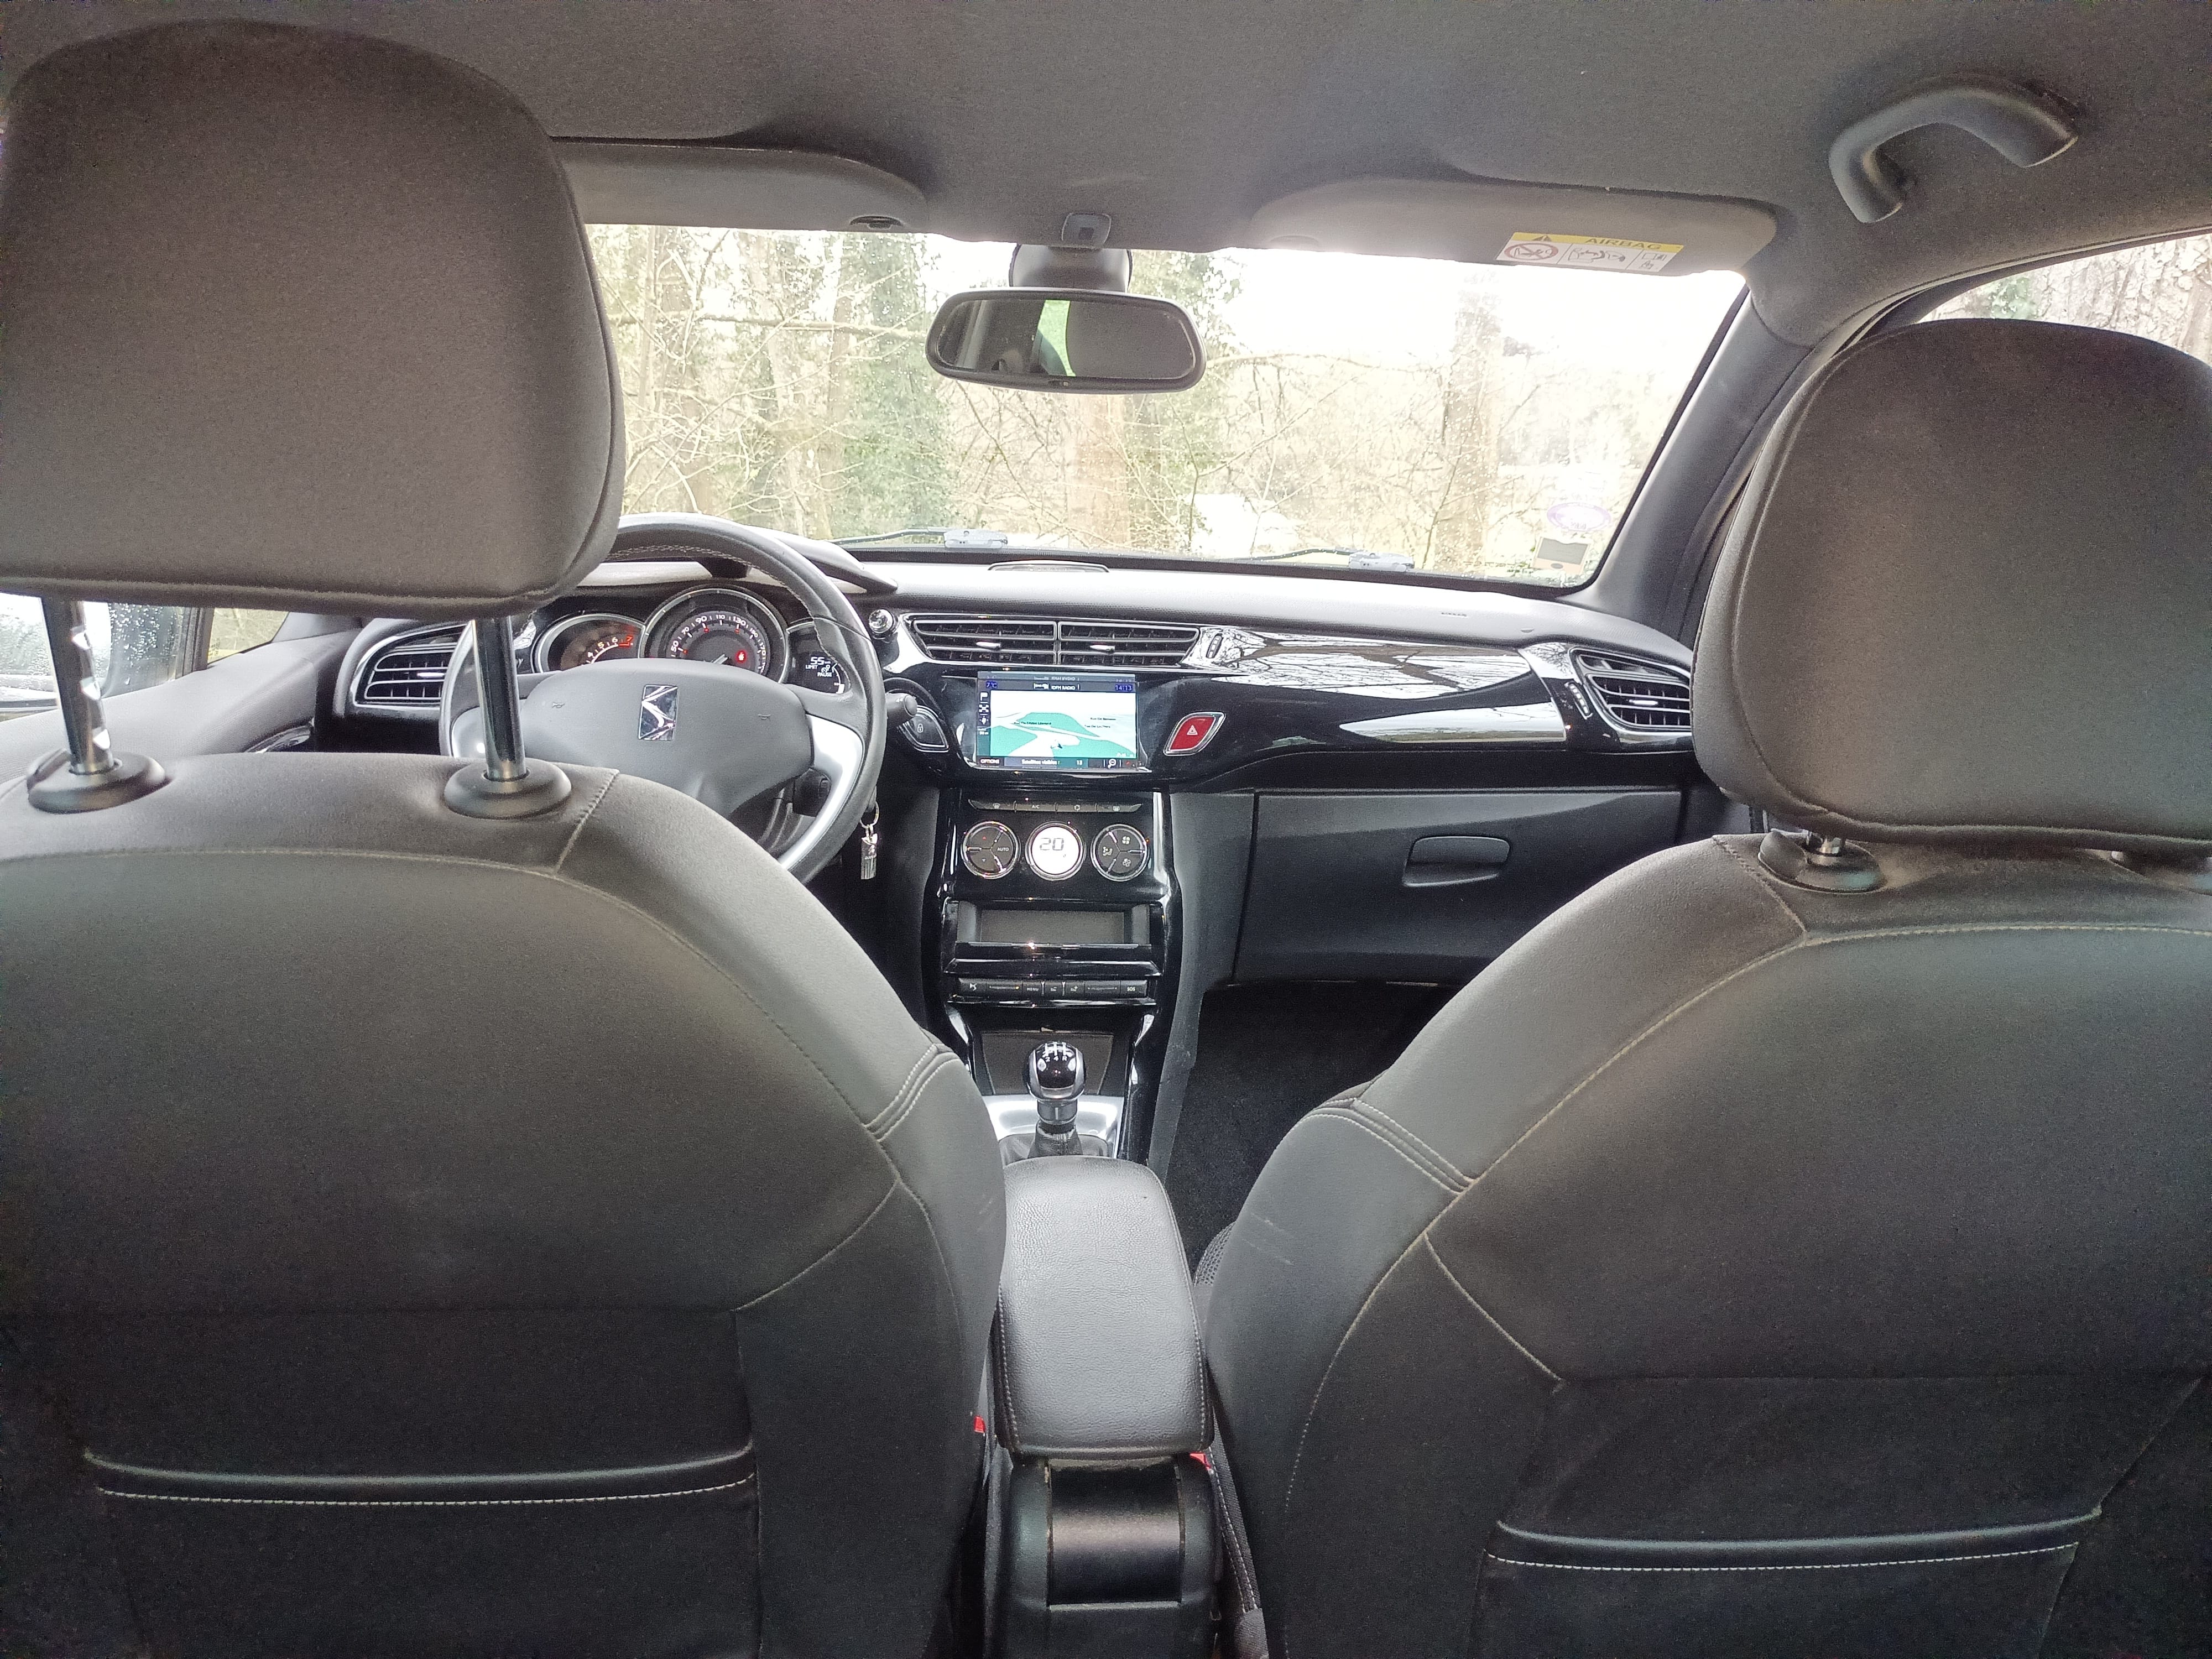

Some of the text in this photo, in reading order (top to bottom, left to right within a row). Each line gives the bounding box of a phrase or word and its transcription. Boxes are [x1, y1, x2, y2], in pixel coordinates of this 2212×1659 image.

[1584, 238, 1661, 249] AIRBAG
[695, 615, 707, 624] 90
[733, 616, 747, 626] 130
[681, 626, 690, 635] 70
[670, 640, 679, 653] 50
[810, 656, 825, 665] 55
[1039, 837, 1065, 851] 20
